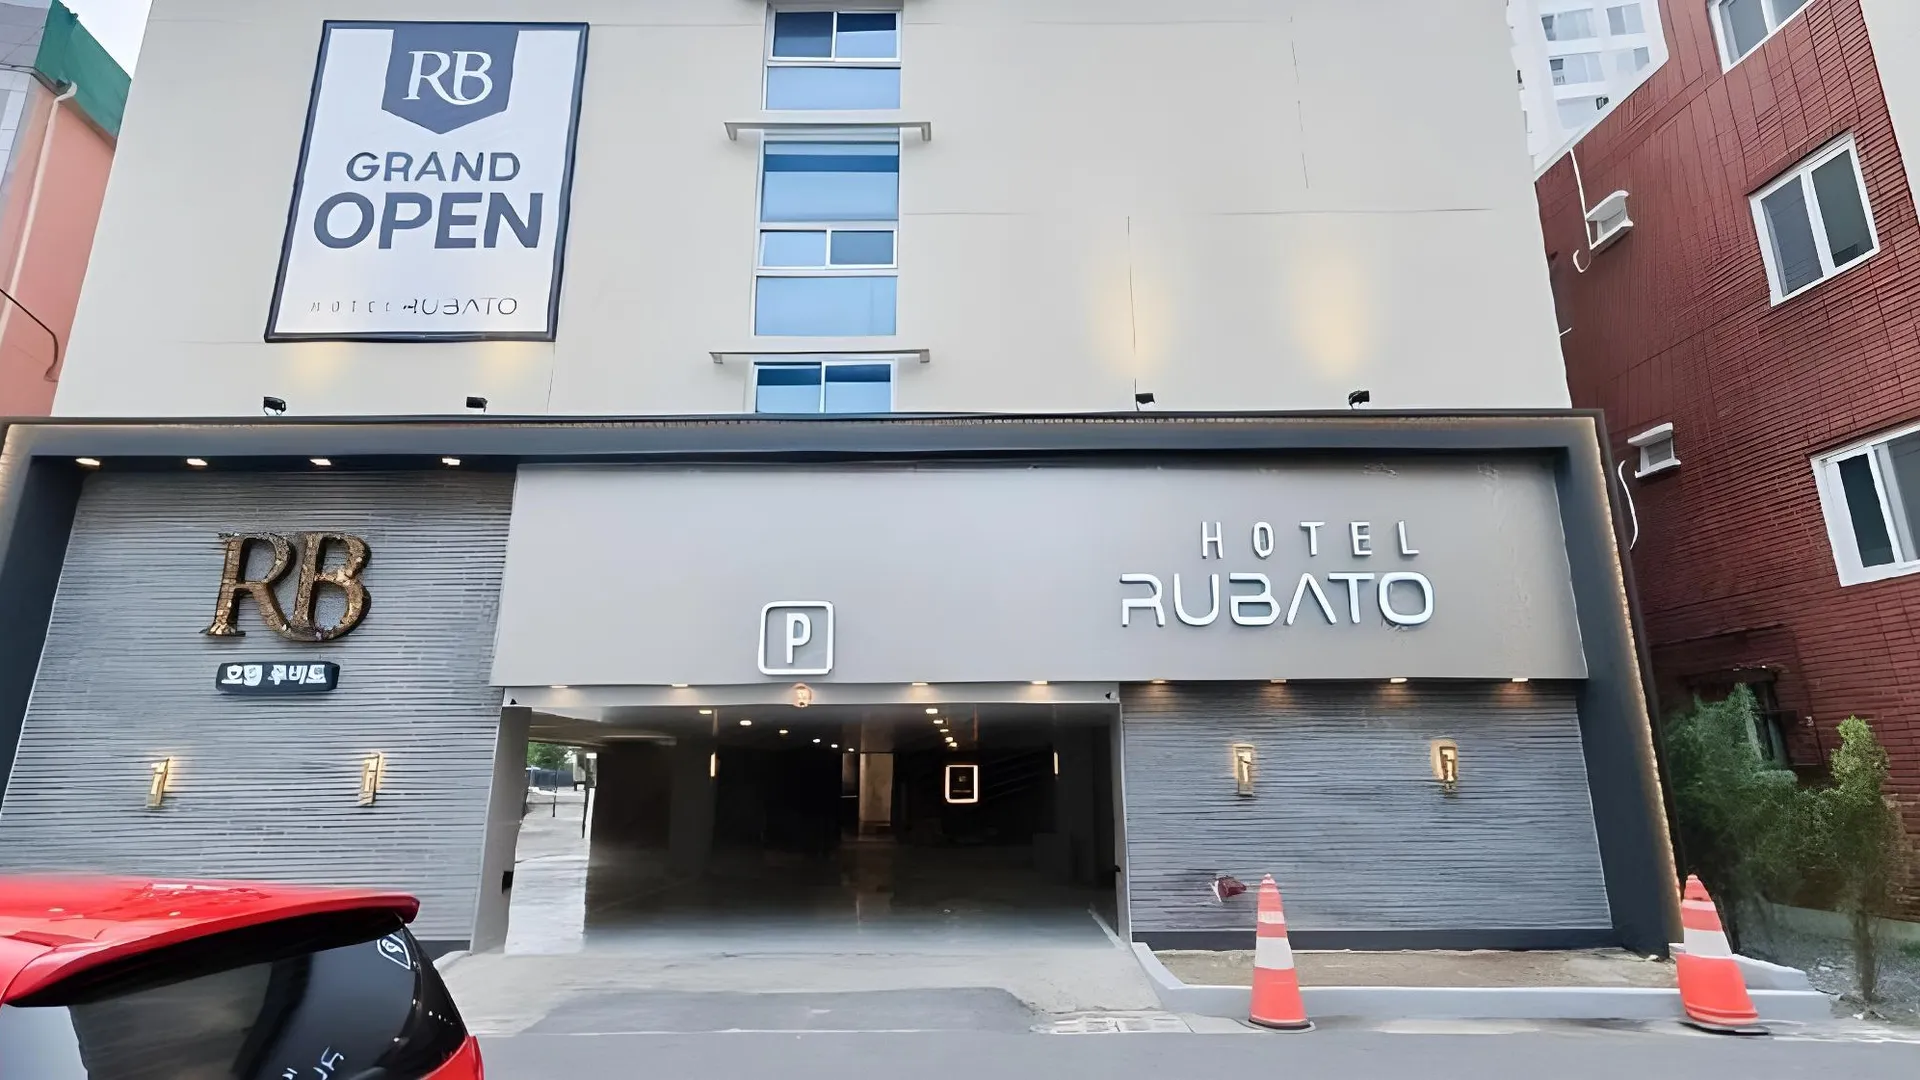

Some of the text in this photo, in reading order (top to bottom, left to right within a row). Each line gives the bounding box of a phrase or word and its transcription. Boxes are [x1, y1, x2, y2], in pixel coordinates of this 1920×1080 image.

[402, 50, 493, 105] RB
[346, 151, 521, 182] GRAND
[313, 192, 544, 249] OPEN
[1200, 520, 1420, 559] HOTEL
[199, 530, 372, 642] RB
[1119, 571, 1435, 627] RUBATO
[786, 612, 811, 664] P
